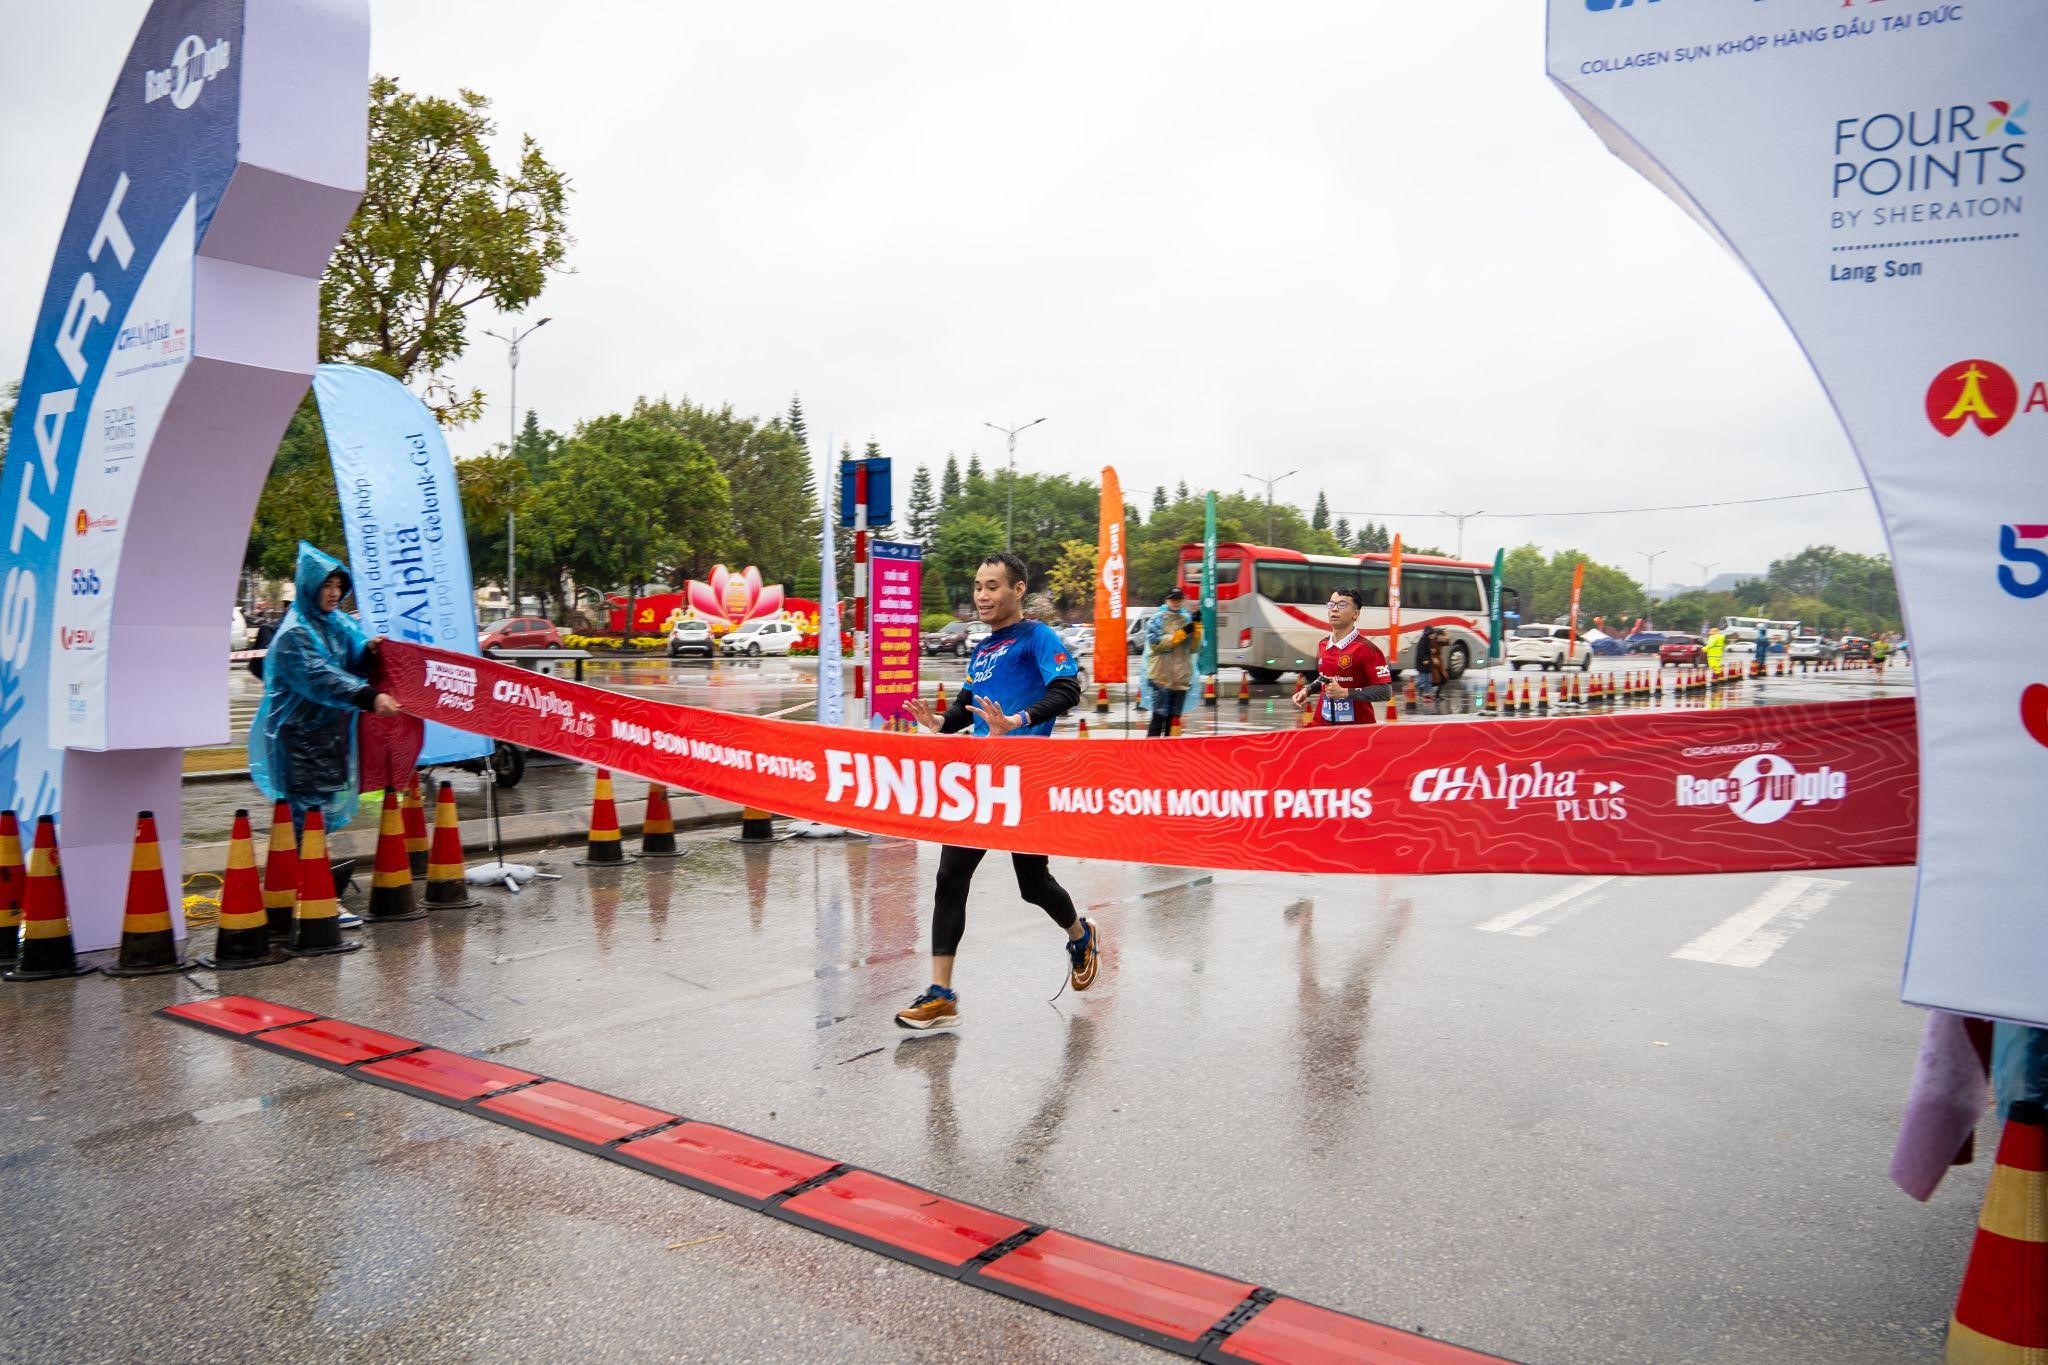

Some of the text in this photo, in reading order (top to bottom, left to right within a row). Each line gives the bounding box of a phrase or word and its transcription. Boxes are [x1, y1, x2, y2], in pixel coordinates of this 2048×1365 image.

[1580, 51, 1670, 75] COLLAGEN
[1675, 45, 1712, 63] SỤN
[1773, 27, 1828, 47] HÀNG
[1882, 14, 1911, 32] TẠI
[1917, 5, 1963, 26] ĐỨC
[1835, 104, 1980, 155] FOUR
[1832, 143, 2026, 198] POINTS
[1831, 195, 2023, 229] BY SHERATON
[1830, 260, 1923, 283] Lang Son
[1, 169, 136, 671] START
[405, 433, 444, 543] Gelenk-Gel
[560, 716, 596, 737] PLUS
[611, 718, 817, 783] MAU SON MOUNT PATHS
[824, 748, 1022, 828] FINISH
[1049, 786, 1374, 819] MAU SON MOUNT PATHS
[1556, 797, 1629, 822] PLUS
